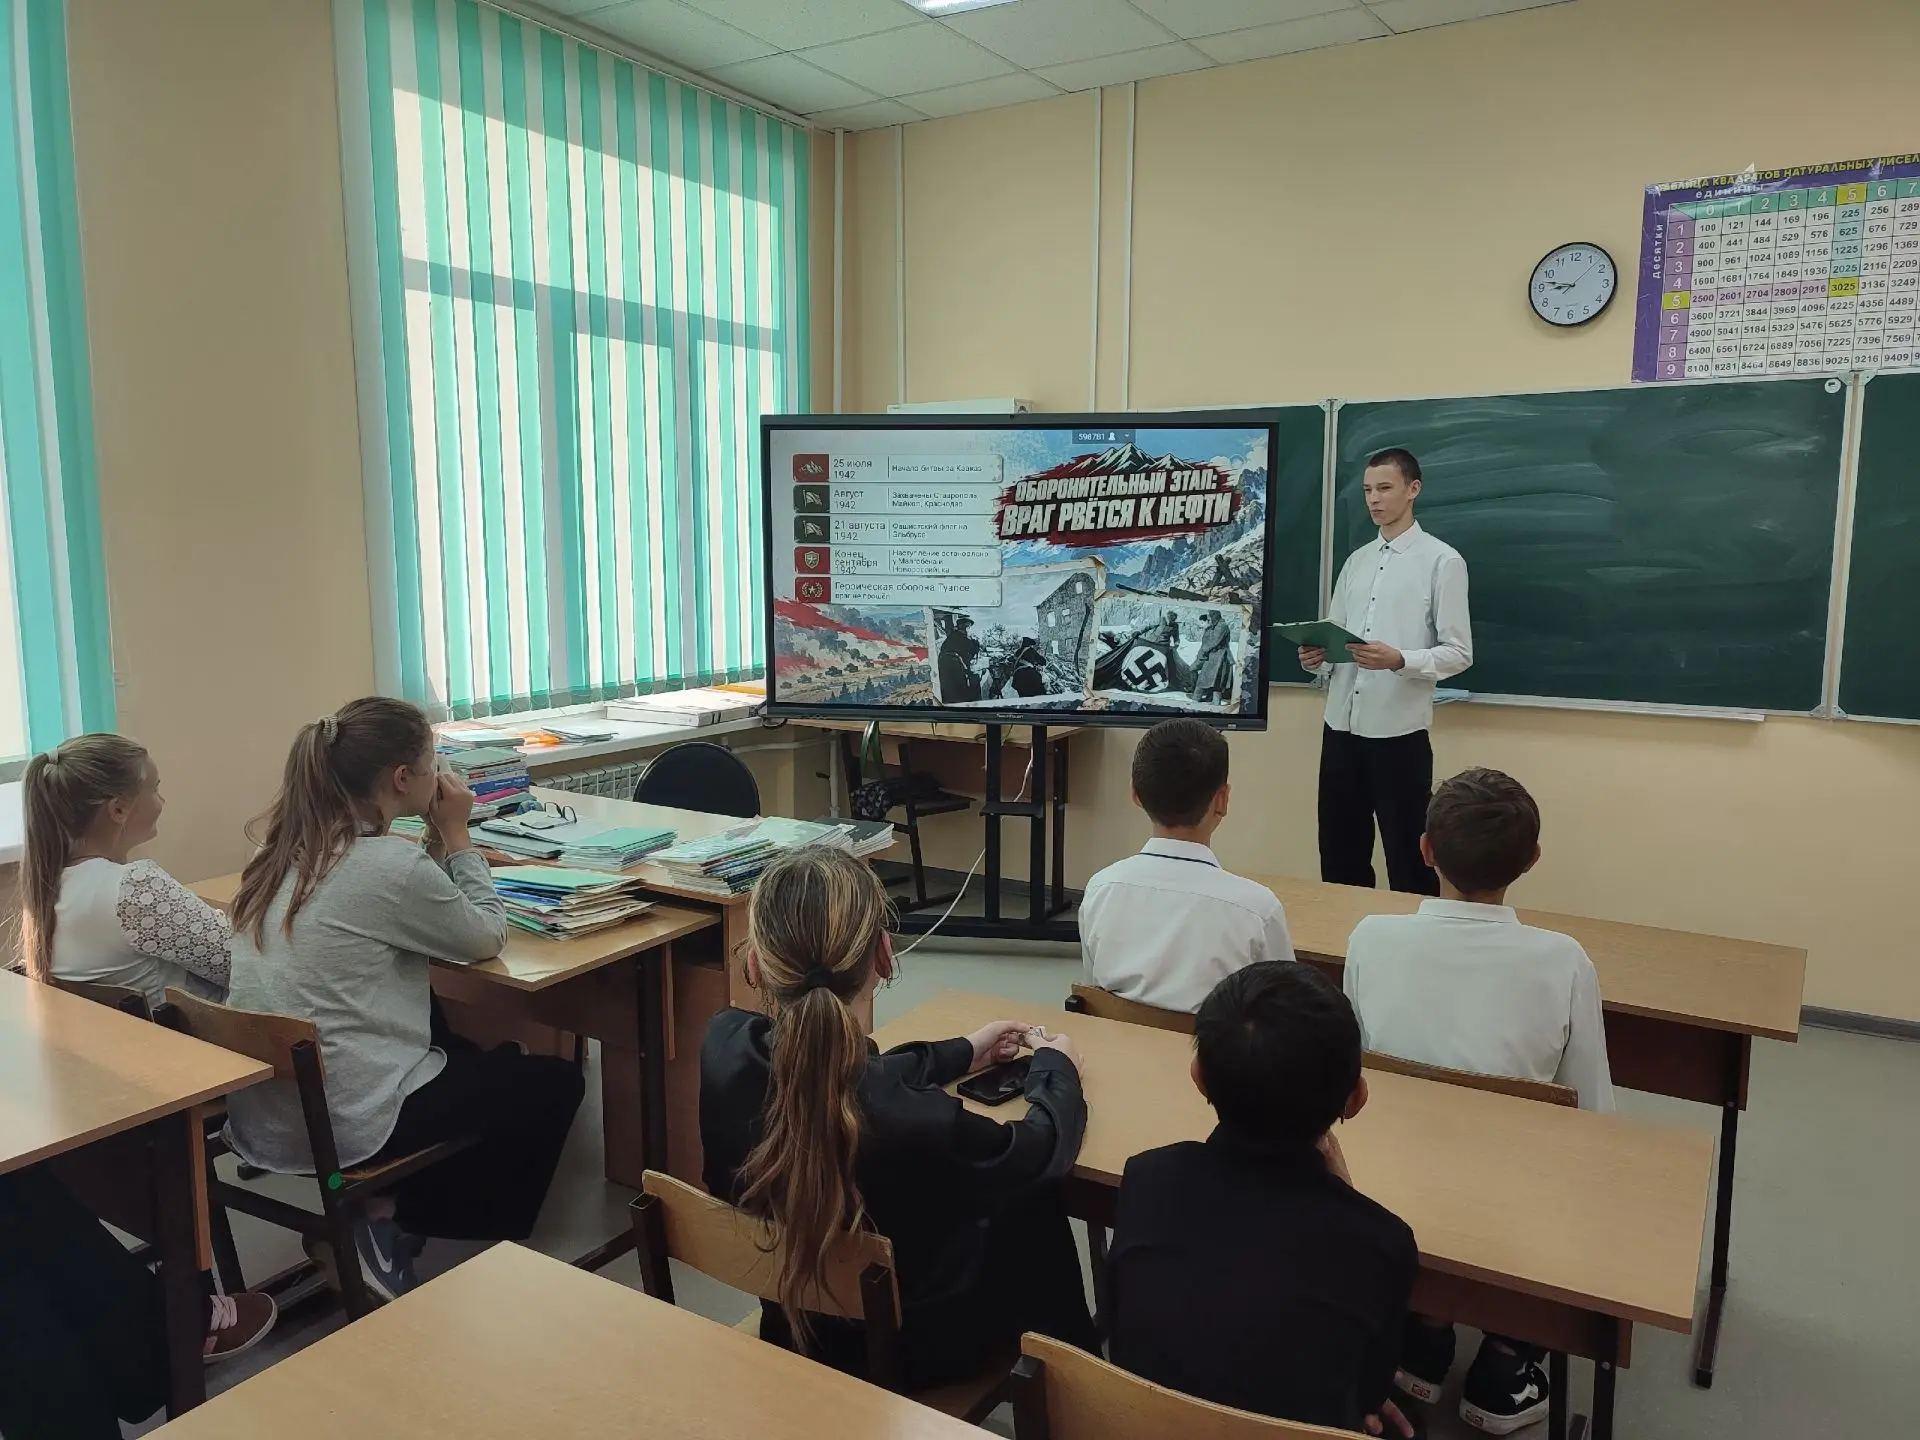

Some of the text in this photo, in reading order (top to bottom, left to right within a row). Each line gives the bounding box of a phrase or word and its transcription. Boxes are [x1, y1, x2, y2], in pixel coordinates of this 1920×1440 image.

[1784, 159, 1874, 178] НАТУРАЛЬНЫХ
[1706, 205, 1714, 215] 0
[1761, 198, 1770, 209] 2
[1789, 195, 1798, 207] 3
[1818, 191, 1827, 204] 4
[1848, 189, 1856, 200] 5
[1877, 186, 1886, 197] 6
[1908, 182, 1917, 194] 7
[1677, 225, 1683, 235] 1
[1700, 224, 1716, 232] 100
[1728, 221, 1744, 229] 121
[1755, 218, 1771, 227] 144
[1784, 215, 1800, 224] 169
[1841, 209, 1860, 218] 225
[1871, 206, 1889, 215] 256
[1901, 203, 1920, 212] 289
[1676, 242, 1684, 254] 2
[1754, 236, 1770, 244] 484
[1782, 233, 1799, 241] 529
[1811, 230, 1828, 238] 576
[1840, 227, 1858, 236] 625
[1869, 224, 1887, 233] 676
[1899, 222, 1917, 230] 729
[1569, 252, 1581, 261] 12
[1653, 224, 1663, 279] Десятки
[1674, 261, 1683, 272] 3
[1750, 254, 1771, 262] 1024
[1777, 251, 1800, 260] 1089
[1806, 248, 1828, 257] 1156
[1835, 246, 1859, 254] 1225
[1864, 243, 1888, 251] 1296
[1895, 241, 1919, 249] 1369
[1556, 258, 1565, 267] 11
[1588, 255, 1593, 263] 1
[1598, 264, 1605, 273] 2
[1544, 270, 1554, 278] 10
[1673, 259, 1918, 289] 4 1600 1681 1764 1849 1936 2025 2116 2209
[1538, 284, 1544, 293] 9
[1602, 279, 1609, 288] 3
[1672, 278, 1916, 306] 5 2500 2601 2704 2809 2916 3025 3136 3249
[1542, 298, 1548, 307] 8
[1595, 294, 1602, 303] 4
[1553, 307, 1560, 317] 7
[1567, 310, 1573, 319] 6
[1583, 305, 1589, 314] 5
[1670, 297, 1914, 324] 6 3600 3721 3844 3969 4096 4225 4356 4489
[1670, 330, 1678, 341] 7
[1690, 329, 1712, 337] 4900
[1717, 327, 1739, 336] 5041
[1744, 325, 1766, 333] 5184
[1772, 323, 1794, 332] 5329
[1828, 319, 1853, 327] 5625
[1858, 318, 1882, 326] 5776
[1888, 315, 1912, 324] 5929
[1668, 347, 1676, 358] 8
[1689, 347, 1710, 355] 6400
[1716, 345, 1738, 353] 6561
[1743, 343, 1765, 351] 6724
[1771, 342, 1793, 350] 6889
[1799, 340, 1822, 348] 7056
[1828, 337, 1851, 346] 7225
[1857, 336, 1880, 344] 7396
[1886, 334, 1911, 342] 7569
[1667, 364, 1676, 374] 9
[1687, 364, 1709, 372] 8100
[1715, 362, 1736, 371] 8281
[1769, 360, 1792, 368] 8649
[1797, 358, 1820, 367] 8836
[1825, 356, 1850, 364] 9025
[1855, 354, 1879, 363] 9216
[1885, 353, 1909, 361] 9409
[833, 459, 872, 468] 25 июля
[834, 471, 856, 479] 1942
[1015, 469, 1217, 502] ОБОРОНИТЕЛЬНЫЙ ЭТАП:
[834, 489, 864, 499] Август
[834, 500, 856, 509] 1942
[1001, 492, 1232, 536] ВРАГ РВЁТСЯ К НЕФТИ
[834, 521, 886, 532] 21 августа
[835, 532, 858, 541] 1942
[835, 550, 864, 559] Конец
[835, 559, 877, 568] сентября
[835, 582, 893, 591] Героическая
[938, 583, 970, 592] Туапсе
